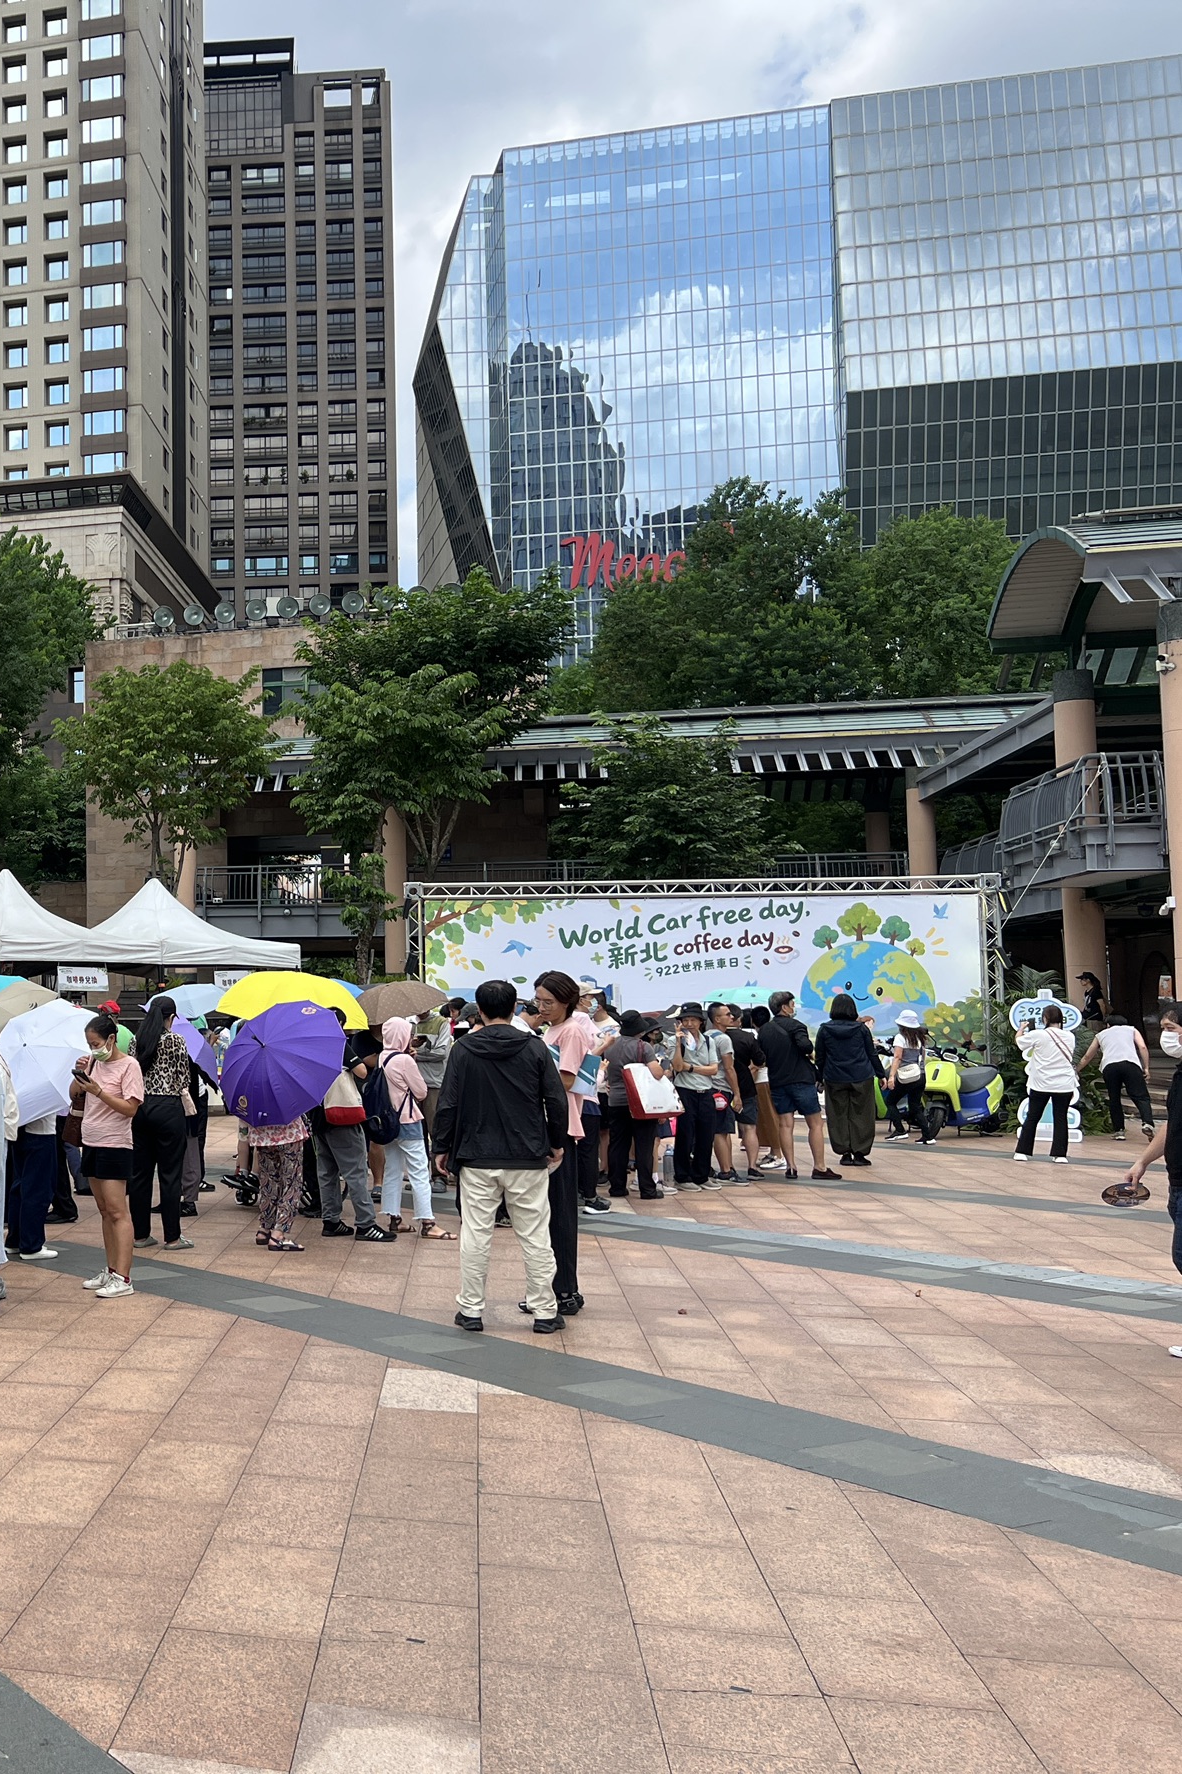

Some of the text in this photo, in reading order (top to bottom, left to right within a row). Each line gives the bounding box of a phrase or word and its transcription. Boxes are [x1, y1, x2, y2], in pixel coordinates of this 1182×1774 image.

[558, 899, 811, 949] World Car free day,
[607, 941, 668, 970] 新北
[673, 933, 733, 956] coffee
[737, 929, 775, 951] day
[655, 957, 740, 978] 922世界無車日
[1028, 1007, 1044, 1016] 92
